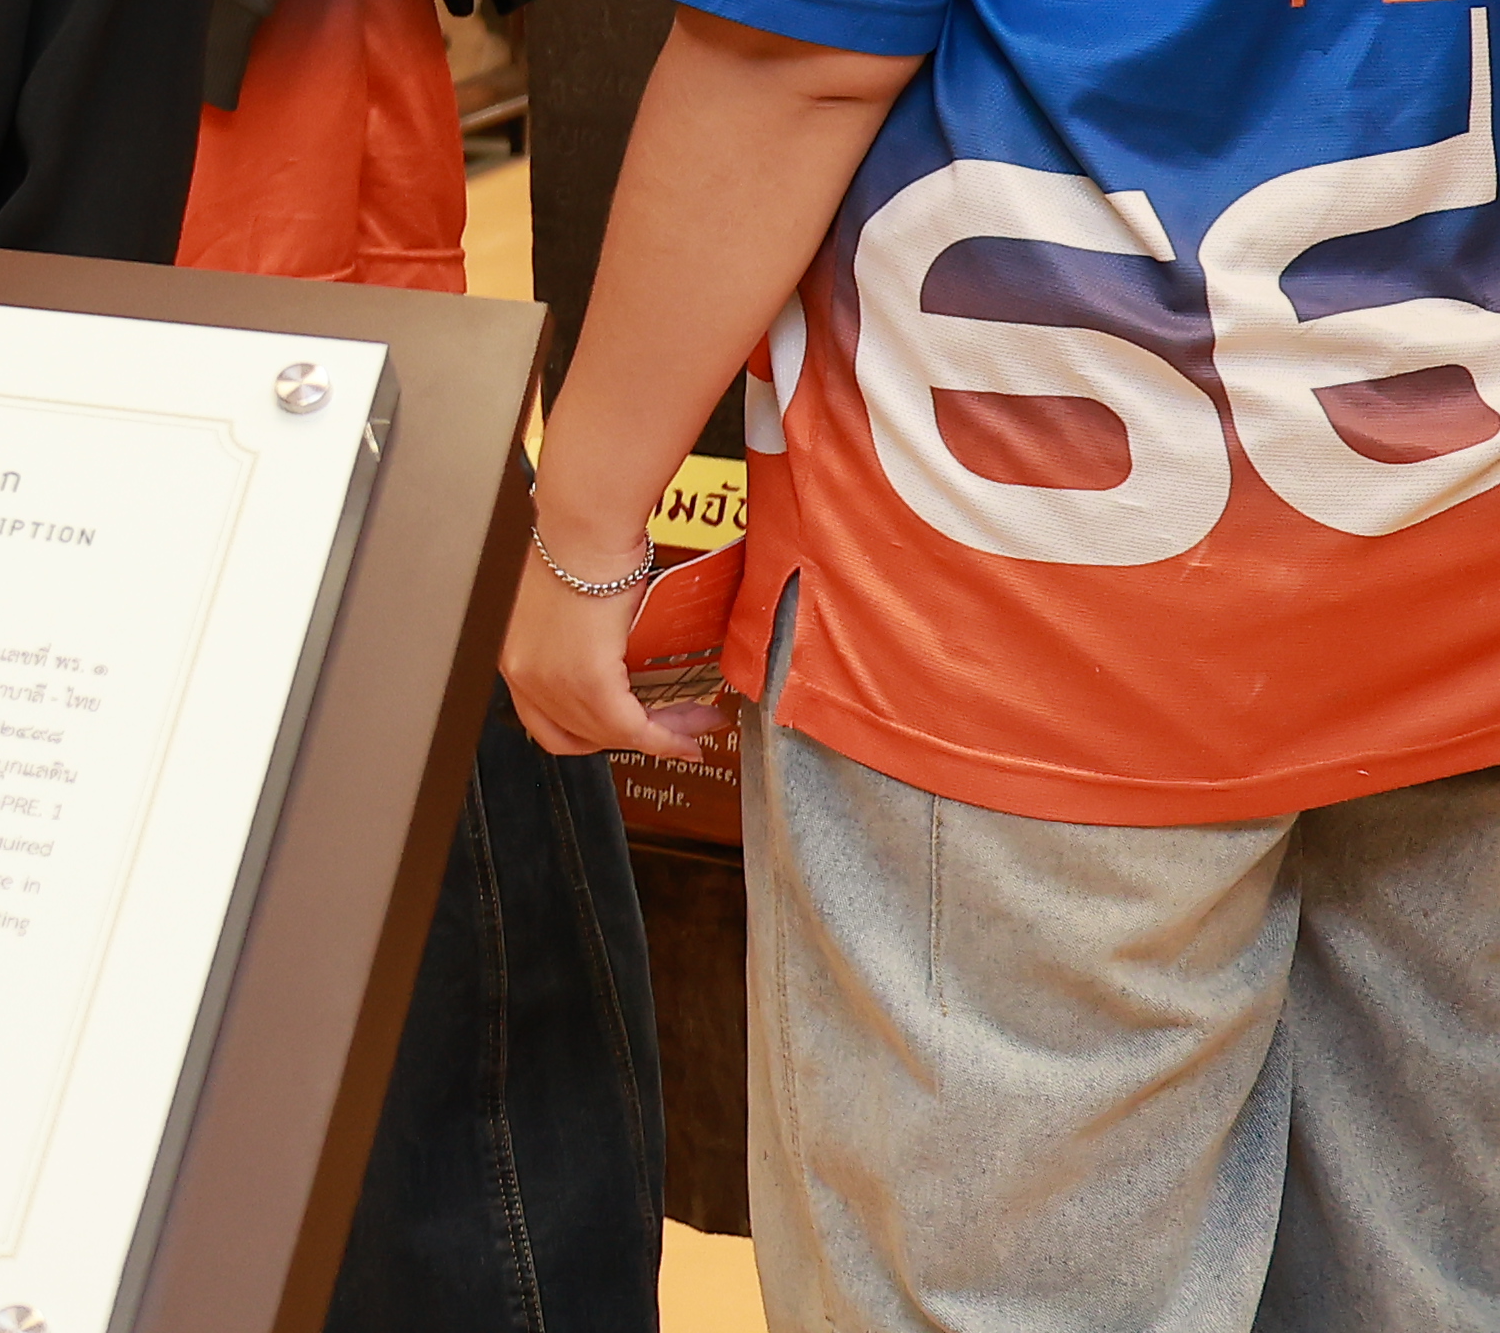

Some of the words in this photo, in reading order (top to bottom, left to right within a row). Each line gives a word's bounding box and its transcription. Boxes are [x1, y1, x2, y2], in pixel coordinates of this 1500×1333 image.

[853, 133, 1500, 565] 66
[0, 642, 52, 668] เลขที่
[93, 664, 110, 677] ๑
[64, 686, 102, 712] ไทย
[0, 794, 43, 819] PRE.
[51, 803, 64, 821] 1
[625, 776, 691, 813] temple.
[22, 876, 42, 895] in
